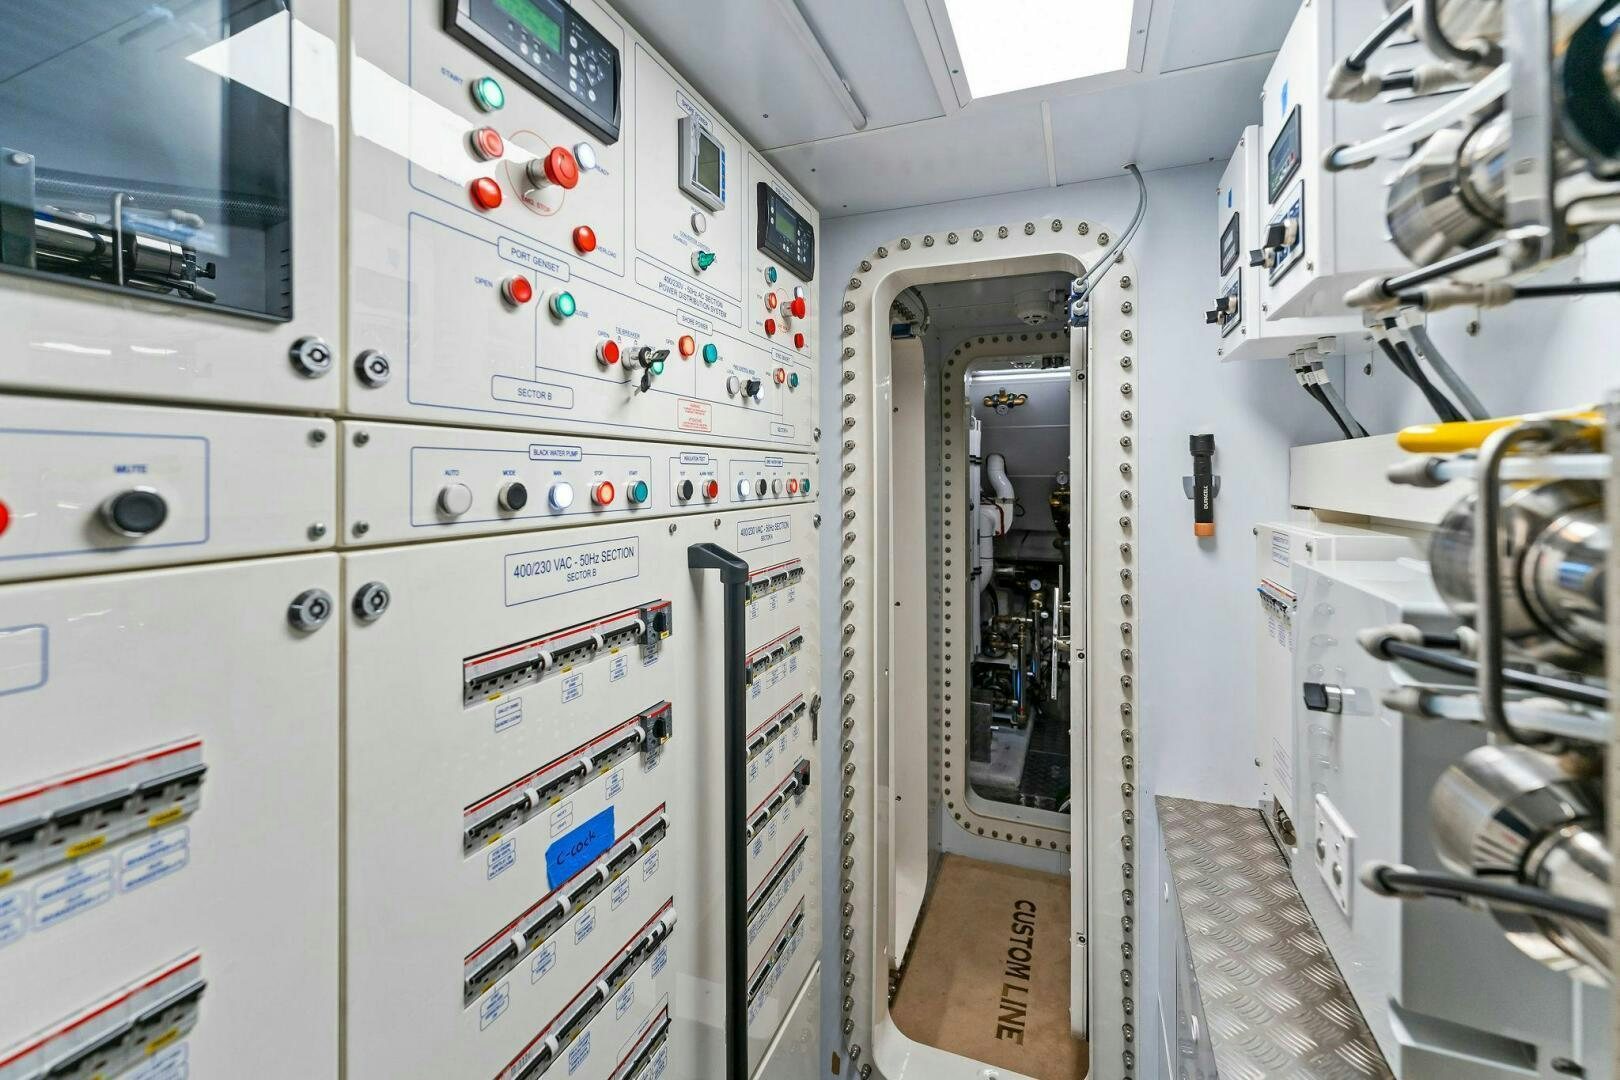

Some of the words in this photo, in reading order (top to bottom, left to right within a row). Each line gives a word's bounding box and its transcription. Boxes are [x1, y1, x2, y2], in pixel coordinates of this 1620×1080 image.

[511, 247, 531, 262] PORT
[532, 256, 560, 273] GENSET
[474, 276, 494, 289] OPEN
[658, 281, 678, 297] POWER
[678, 291, 710, 311] DISTRIBUTION
[710, 305, 727, 319] SYSTEM
[698, 291, 705, 300] AC
[704, 294, 723, 309] SECTION
[575, 309, 589, 318] LOSE
[597, 329, 610, 338] OPEN
[517, 387, 547, 400] SECTOR
[547, 392, 553, 401] B
[533, 448, 549, 456] BLACK
[549, 449, 565, 457] WATER
[113, 463, 148, 475] MUTE
[774, 521, 789, 531] SECTION
[513, 559, 552, 579] 400/230
[553, 556, 573, 571] VAC
[579, 552, 600, 567] 50Hz
[601, 546, 635, 563] SECTION
[566, 570, 592, 582] SECTOR
[592, 568, 597, 577] B
[1004, 899, 1037, 982] CUSTOM
[995, 982, 1029, 1047] LINE
